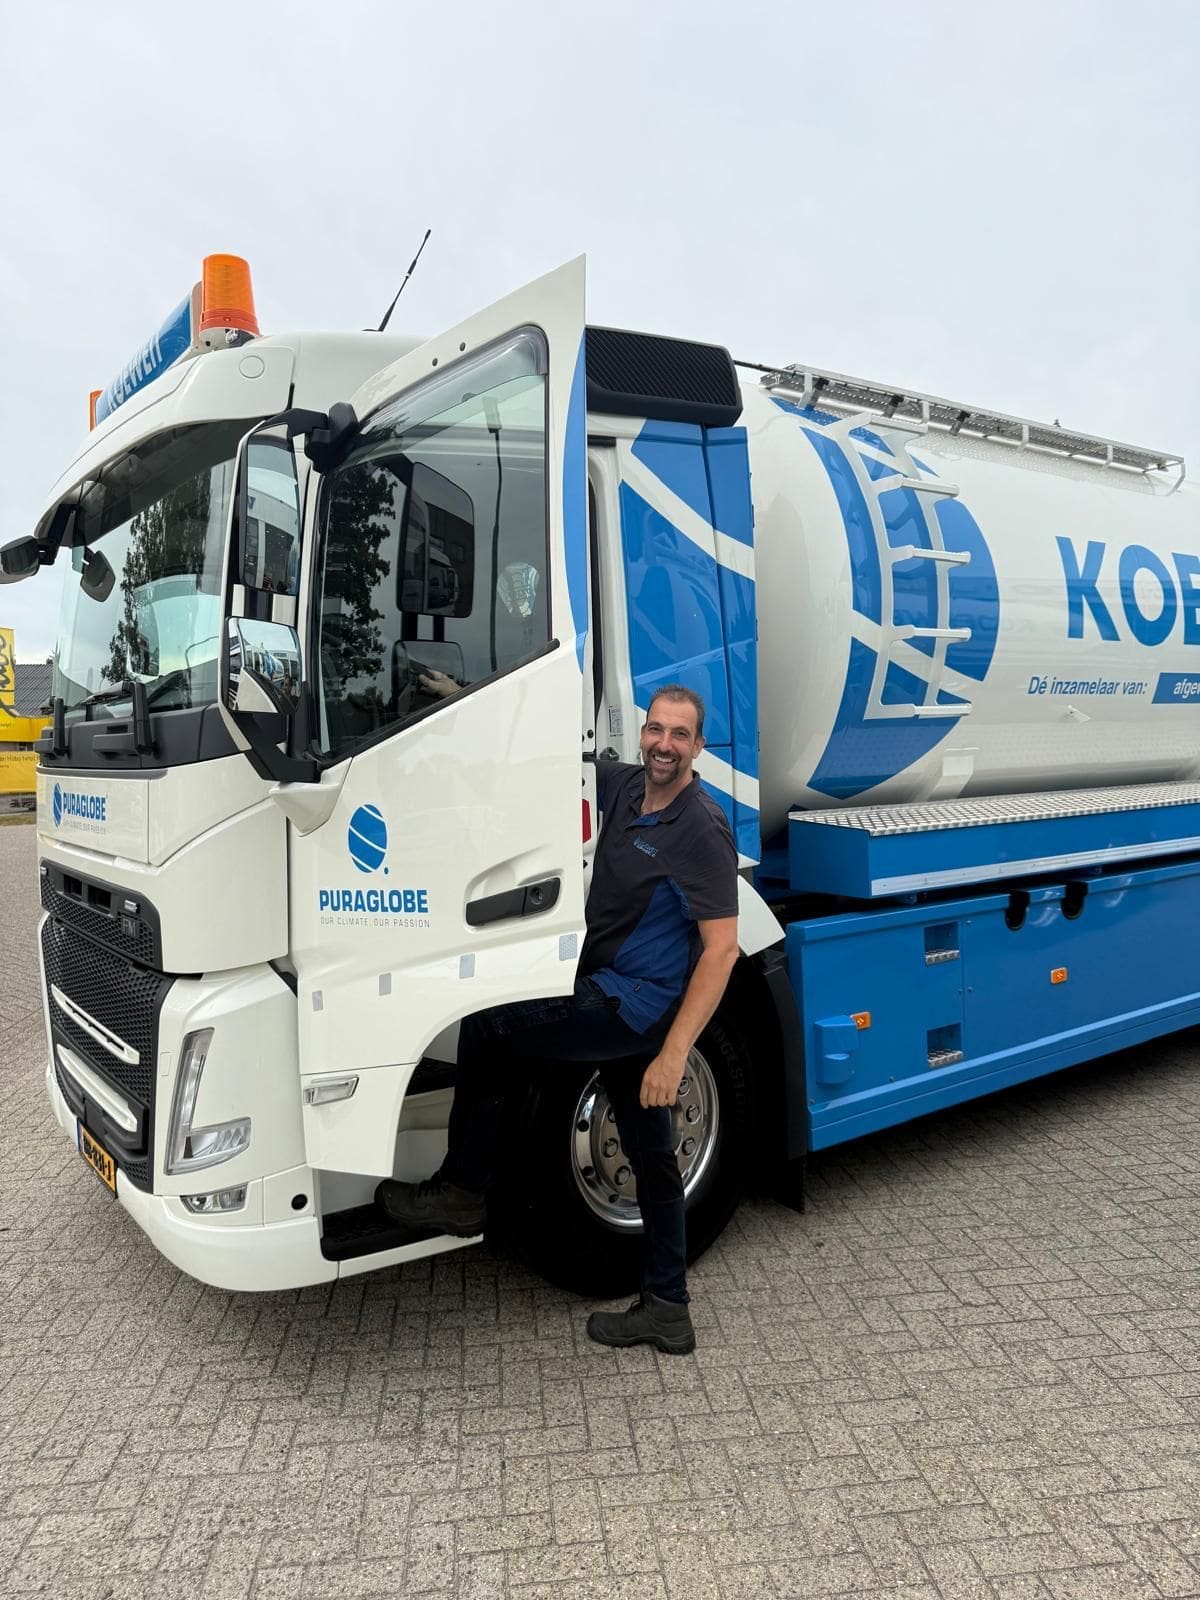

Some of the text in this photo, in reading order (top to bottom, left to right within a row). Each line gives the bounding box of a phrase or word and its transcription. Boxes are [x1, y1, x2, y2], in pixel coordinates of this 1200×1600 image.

[1028, 676, 1047, 695] Dé
[1050, 677, 1120, 695] inzamelaar
[1122, 682, 1148, 695] van:
[63, 792, 106, 821] PURAGLOBE
[319, 889, 429, 913] PURAGLOBE
[320, 916, 334, 925] OUR
[373, 918, 391, 927] OUR
[393, 919, 430, 928] PASSION
